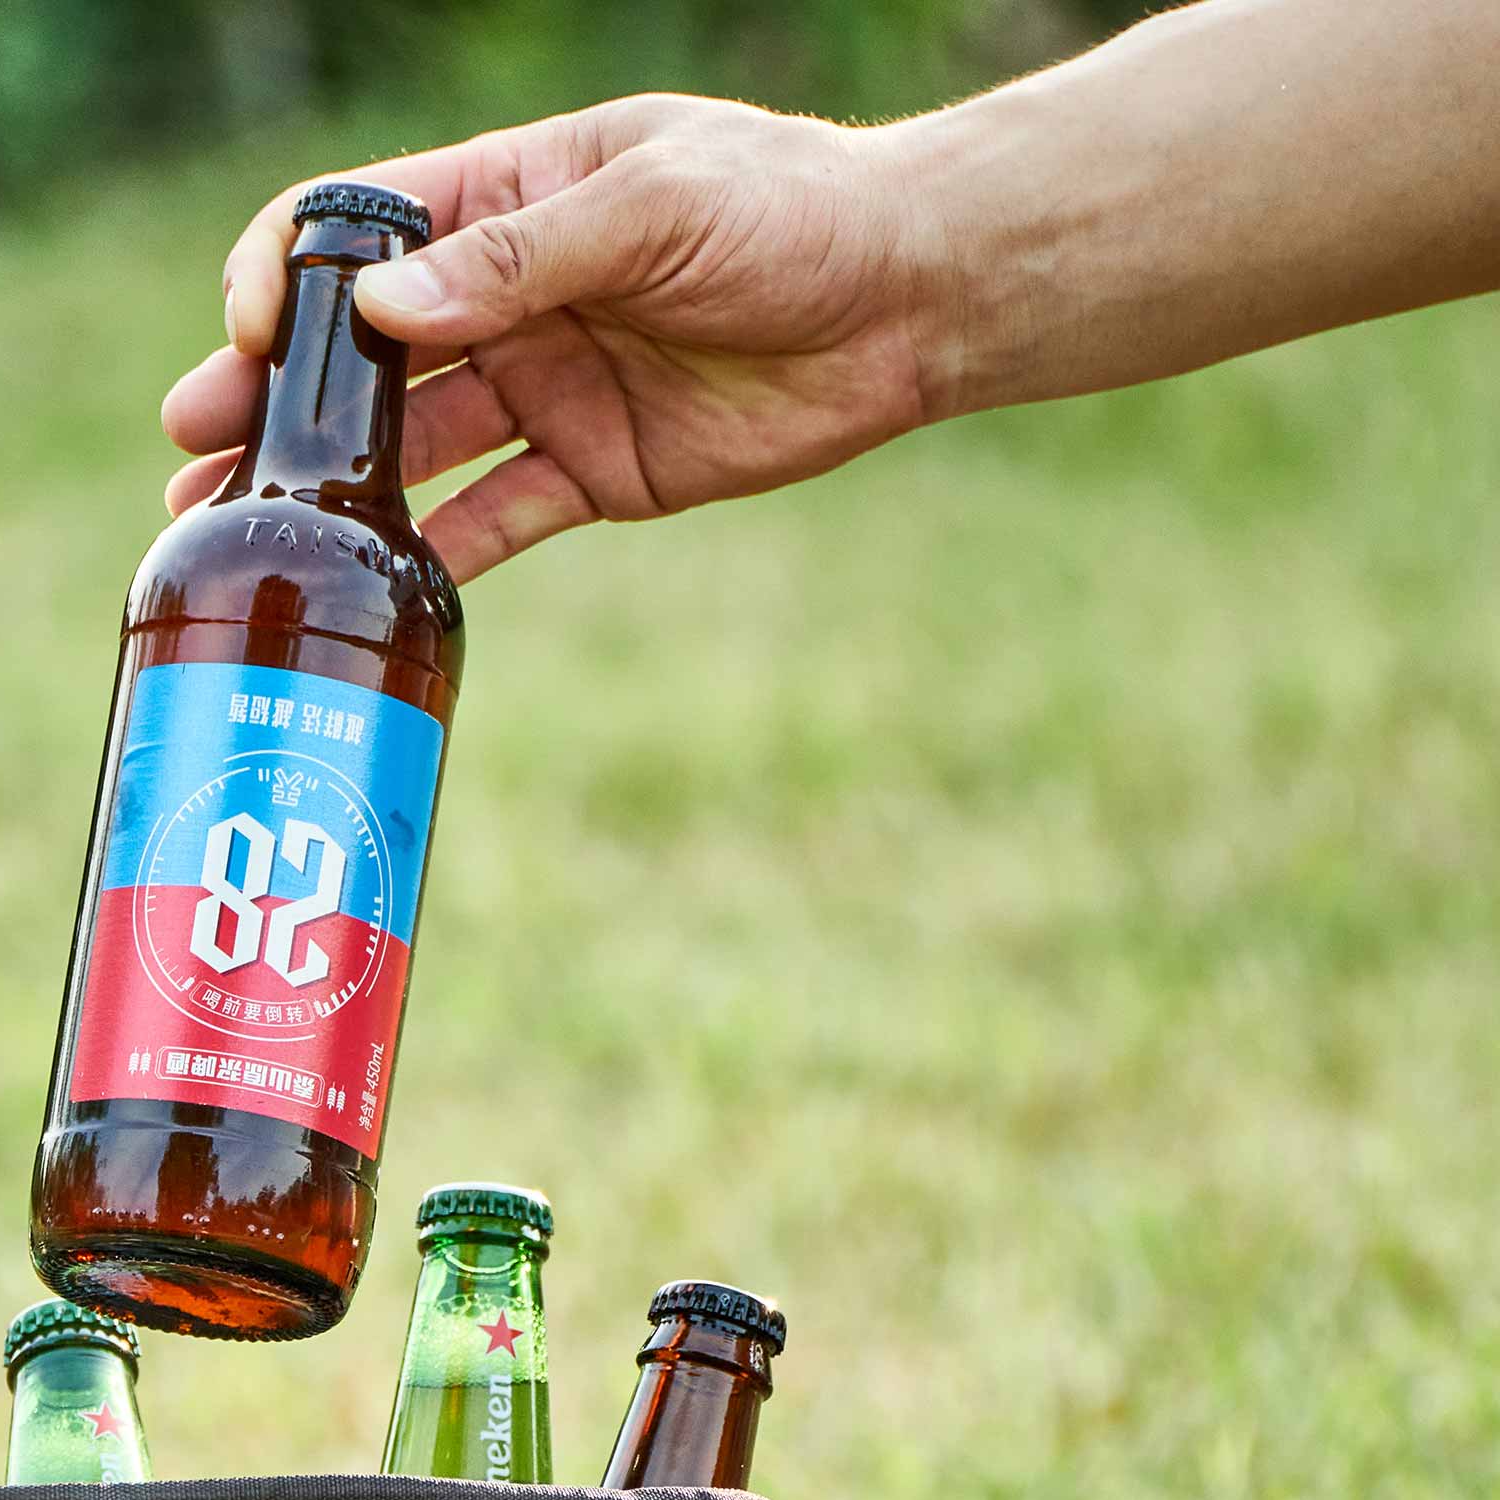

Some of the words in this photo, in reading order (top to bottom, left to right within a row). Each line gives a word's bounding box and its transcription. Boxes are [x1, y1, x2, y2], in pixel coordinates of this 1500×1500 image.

[202, 989, 303, 1023] 喝前要倒转
[167, 1051, 315, 1100] 泰山原浆啤酒
